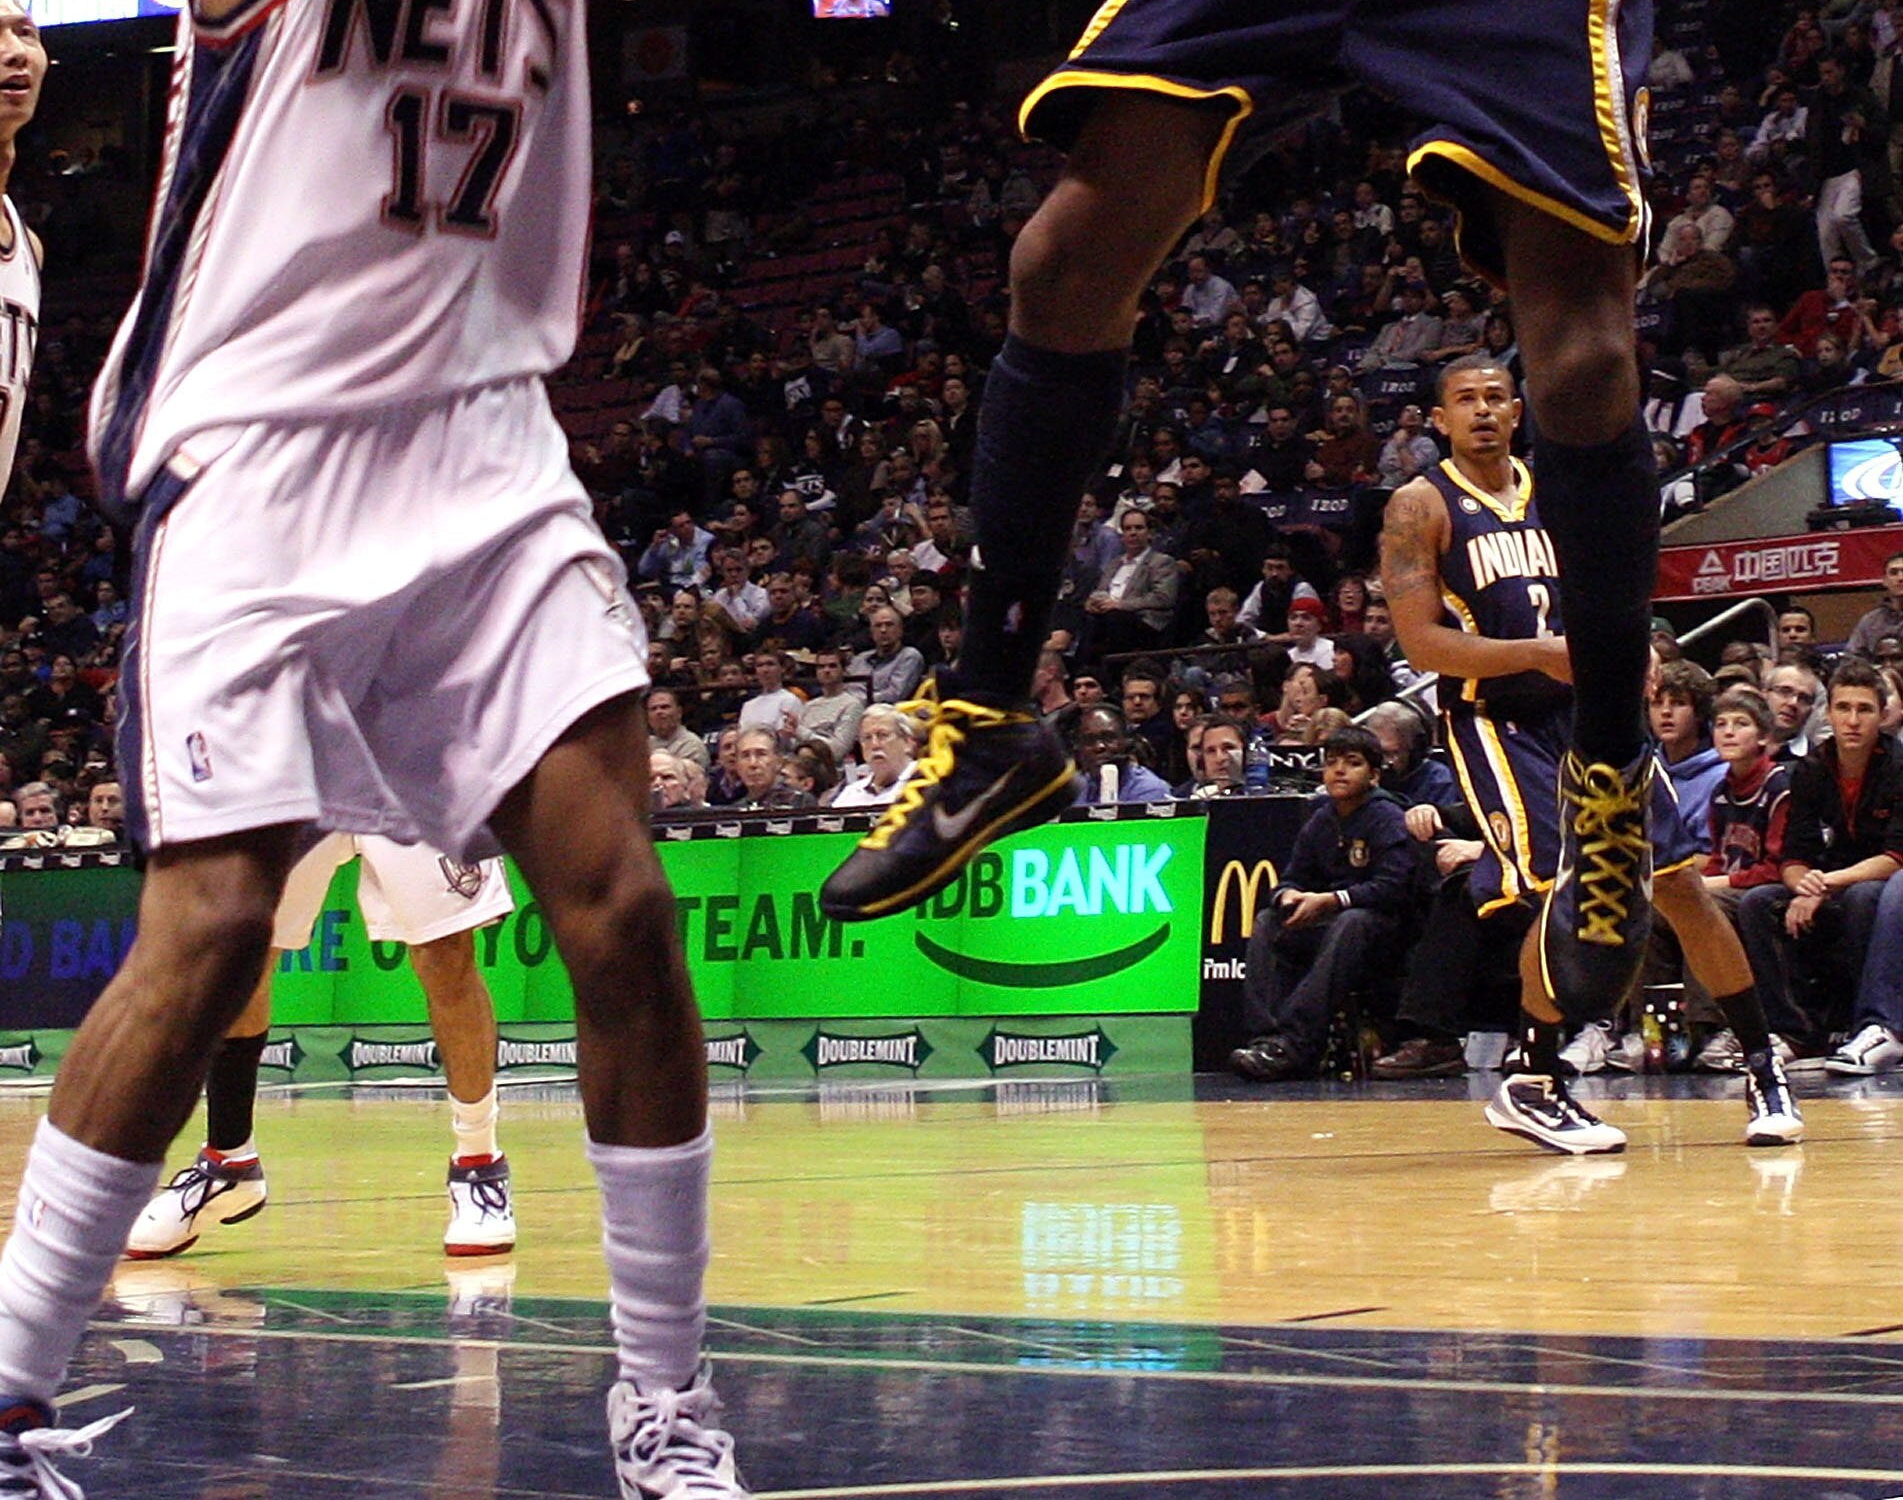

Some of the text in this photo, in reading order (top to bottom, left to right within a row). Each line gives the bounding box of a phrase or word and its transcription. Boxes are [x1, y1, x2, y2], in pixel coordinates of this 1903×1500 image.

[380, 85, 525, 241] 17
[1732, 541, 1841, 583] 中国匹克
[1010, 842, 1174, 919] BANK
[818, 1036, 919, 1066] DOUBLEMINT
[995, 1035, 1101, 1066] DOUBLEMINT
